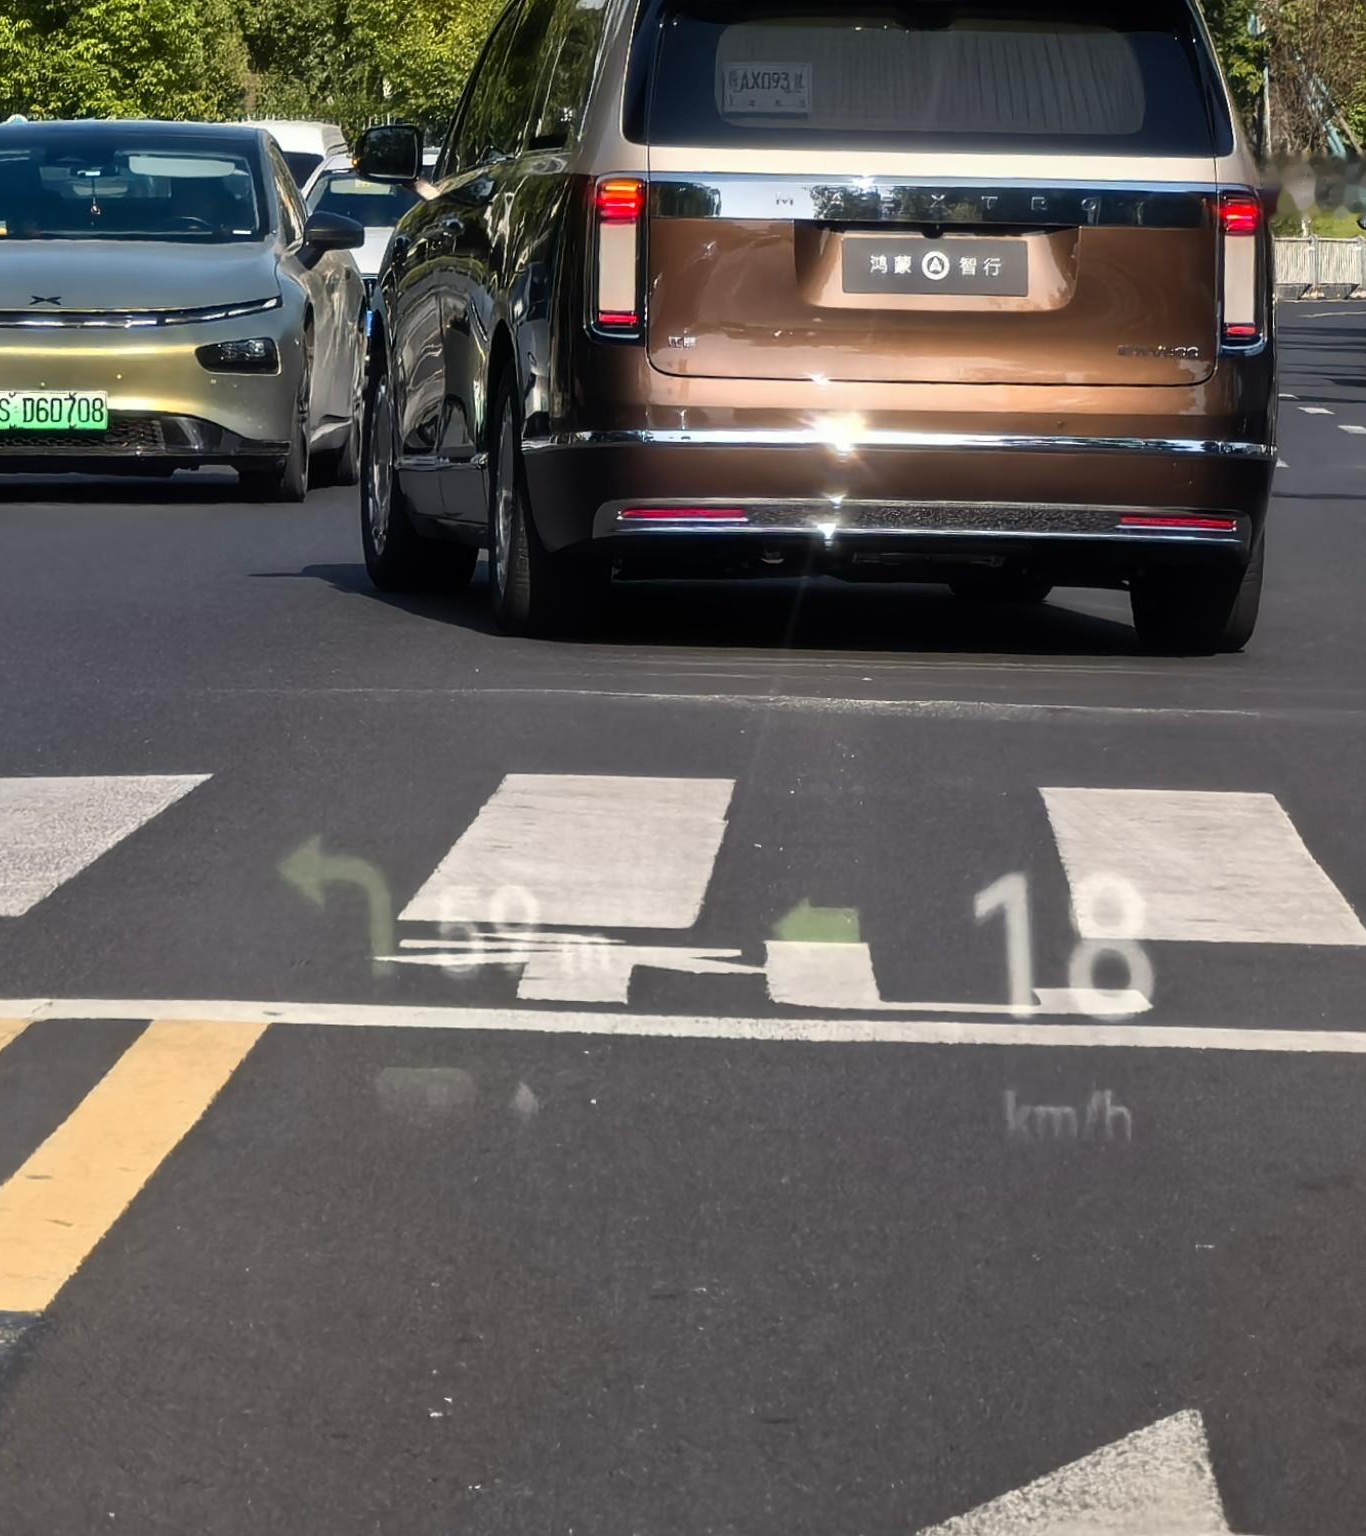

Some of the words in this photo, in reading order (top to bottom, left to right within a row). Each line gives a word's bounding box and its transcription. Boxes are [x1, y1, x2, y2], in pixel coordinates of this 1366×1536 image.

[869, 255, 912, 275] 鸿蒙
[959, 257, 1002, 276] 智行
[973, 870, 1155, 1022] 18
[1005, 1082, 1133, 1141] km/h
